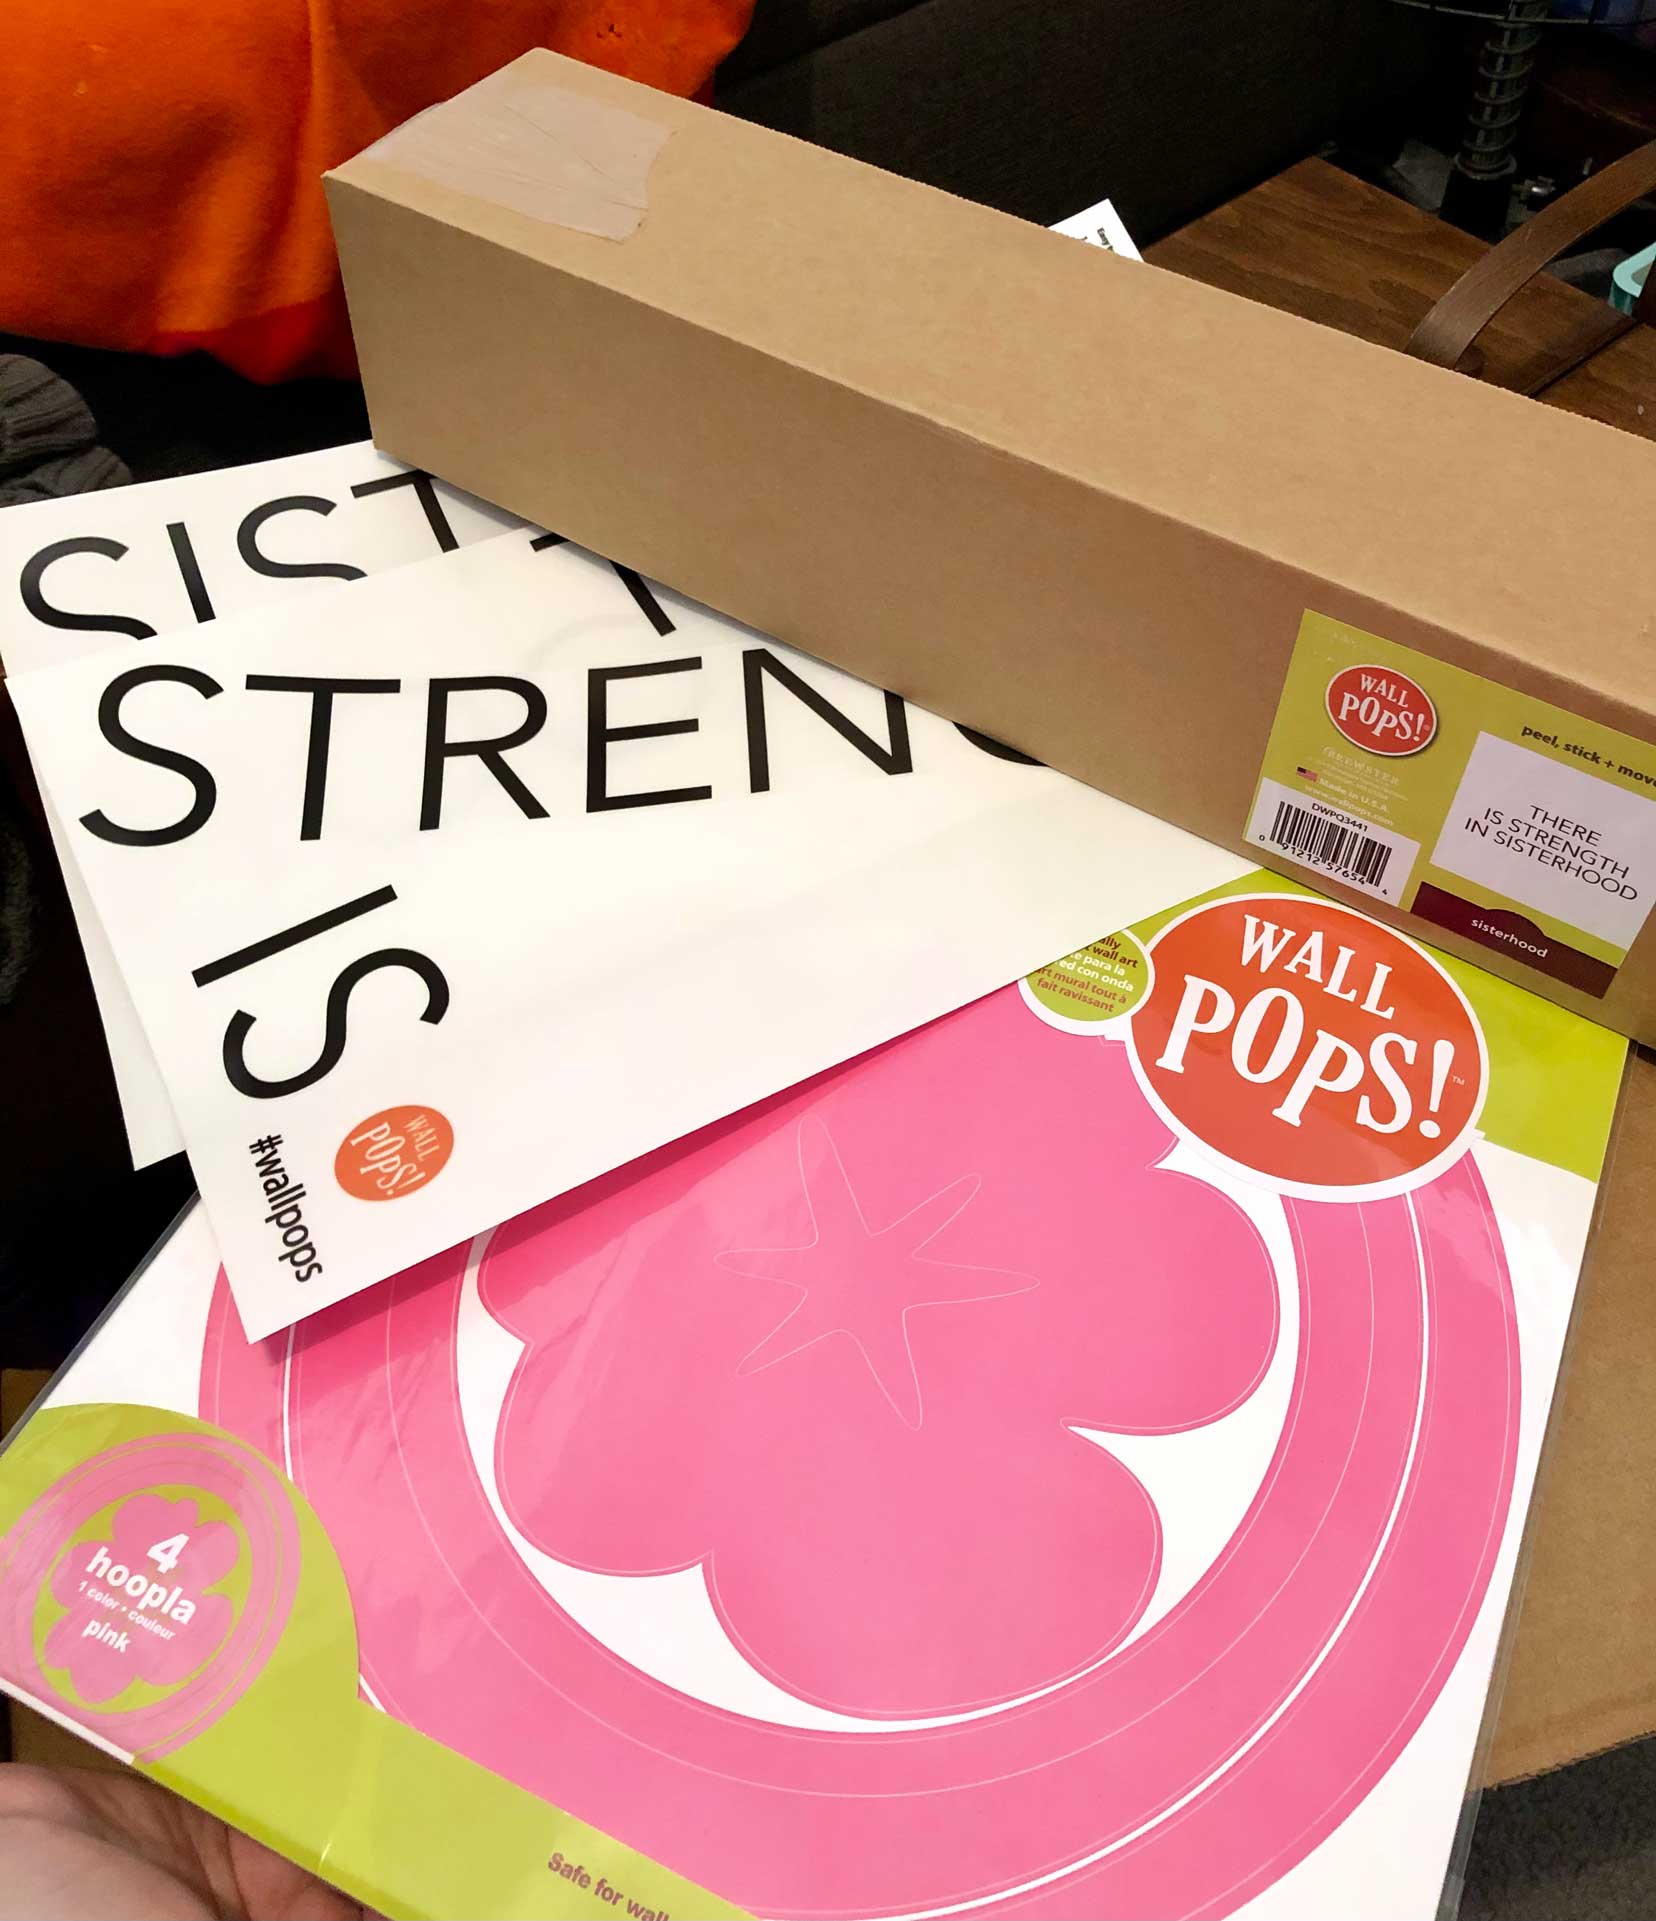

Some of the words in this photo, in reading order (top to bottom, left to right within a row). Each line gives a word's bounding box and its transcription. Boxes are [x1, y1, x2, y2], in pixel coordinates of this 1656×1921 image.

[1360, 673, 1409, 708] WALL
[1338, 692, 1425, 742] POPS!
[79, 648, 1049, 847] STREN
[1521, 725, 1560, 748] peel,
[1563, 740, 1601, 764] stick
[1311, 802, 1368, 832] DWPQ3441
[1530, 804, 1603, 847] THERE
[1464, 817, 1489, 838] IN
[1493, 830, 1638, 901] SISTERHOOD
[1484, 807, 1505, 825] IS
[1508, 818, 1630, 879] STRENGTH
[1093, 944, 1119, 961] wall
[1118, 956, 1138, 969] art
[1471, 917, 1549, 959] sisterhood
[1053, 971, 1090, 991] mural
[1090, 983, 1118, 1001] tout
[1055, 959, 1076, 971] ed
[1077, 965, 1099, 980] con
[1100, 973, 1135, 993] onda
[1082, 955, 1112, 972] para
[1113, 963, 1126, 977] la
[1237, 914, 1395, 1020] WALL
[191, 884, 451, 1099] IS
[1036, 977, 1058, 993] fait
[1058, 986, 1115, 1013] ravissant
[1155, 974, 1456, 1139] POPS!
[349, 1122, 427, 1196] POPS!
[403, 1114, 441, 1163] WALL
[248, 1133, 324, 1283] #wallpops
[145, 1532, 191, 1576] 4
[85, 1546, 198, 1626] hoopla
[81, 1619, 132, 1653] pink
[86, 1585, 121, 1612] color
[127, 1609, 177, 1641] couleur
[547, 1852, 592, 1889] Safe
[594, 1877, 625, 1906] for
